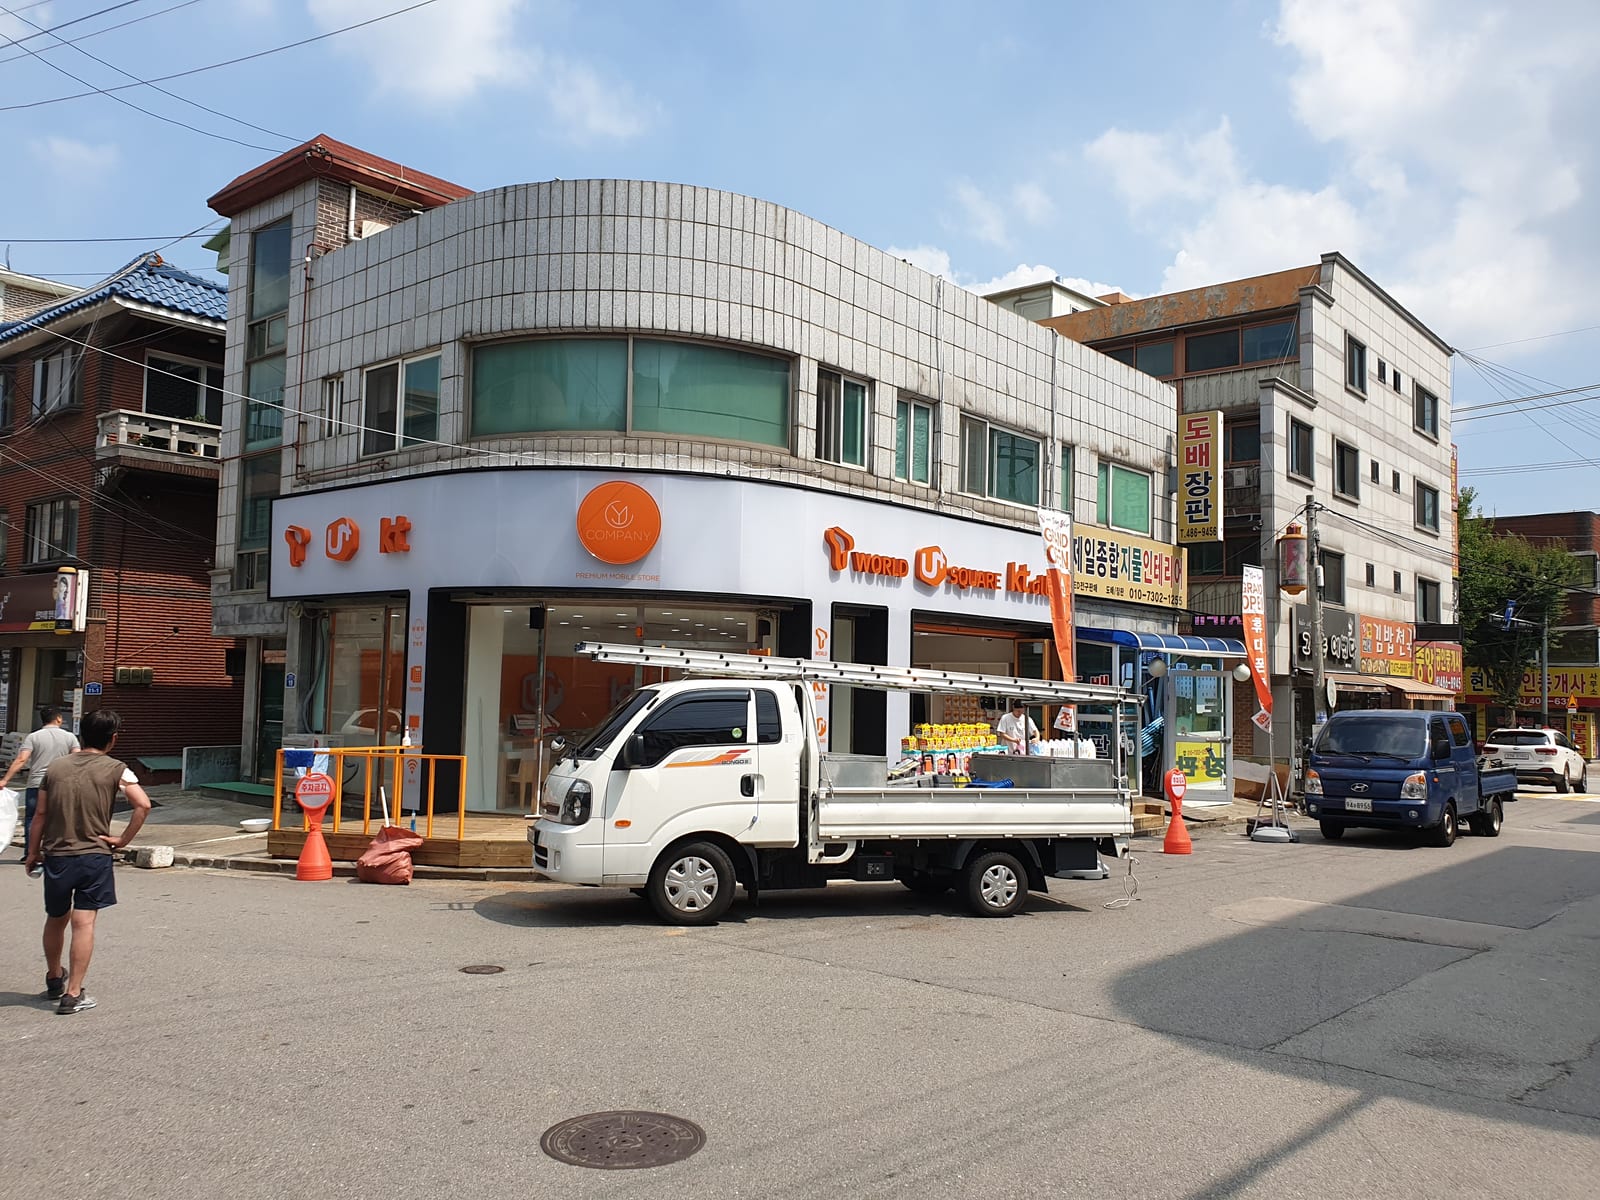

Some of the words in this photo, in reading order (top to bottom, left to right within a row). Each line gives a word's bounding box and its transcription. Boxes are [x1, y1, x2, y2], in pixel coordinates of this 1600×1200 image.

[1184, 417, 1212, 523] 도배장판
[379, 516, 411, 553] kt
[586, 530, 651, 541] COMPANY
[638, 574, 660, 582] STORE
[851, 552, 909, 577] WORLD
[947, 566, 1002, 590] SQUARE
[1007, 562, 1030, 592] kt
[1415, 645, 1434, 684] 중앙
[302, 783, 327, 792] 주차금지
